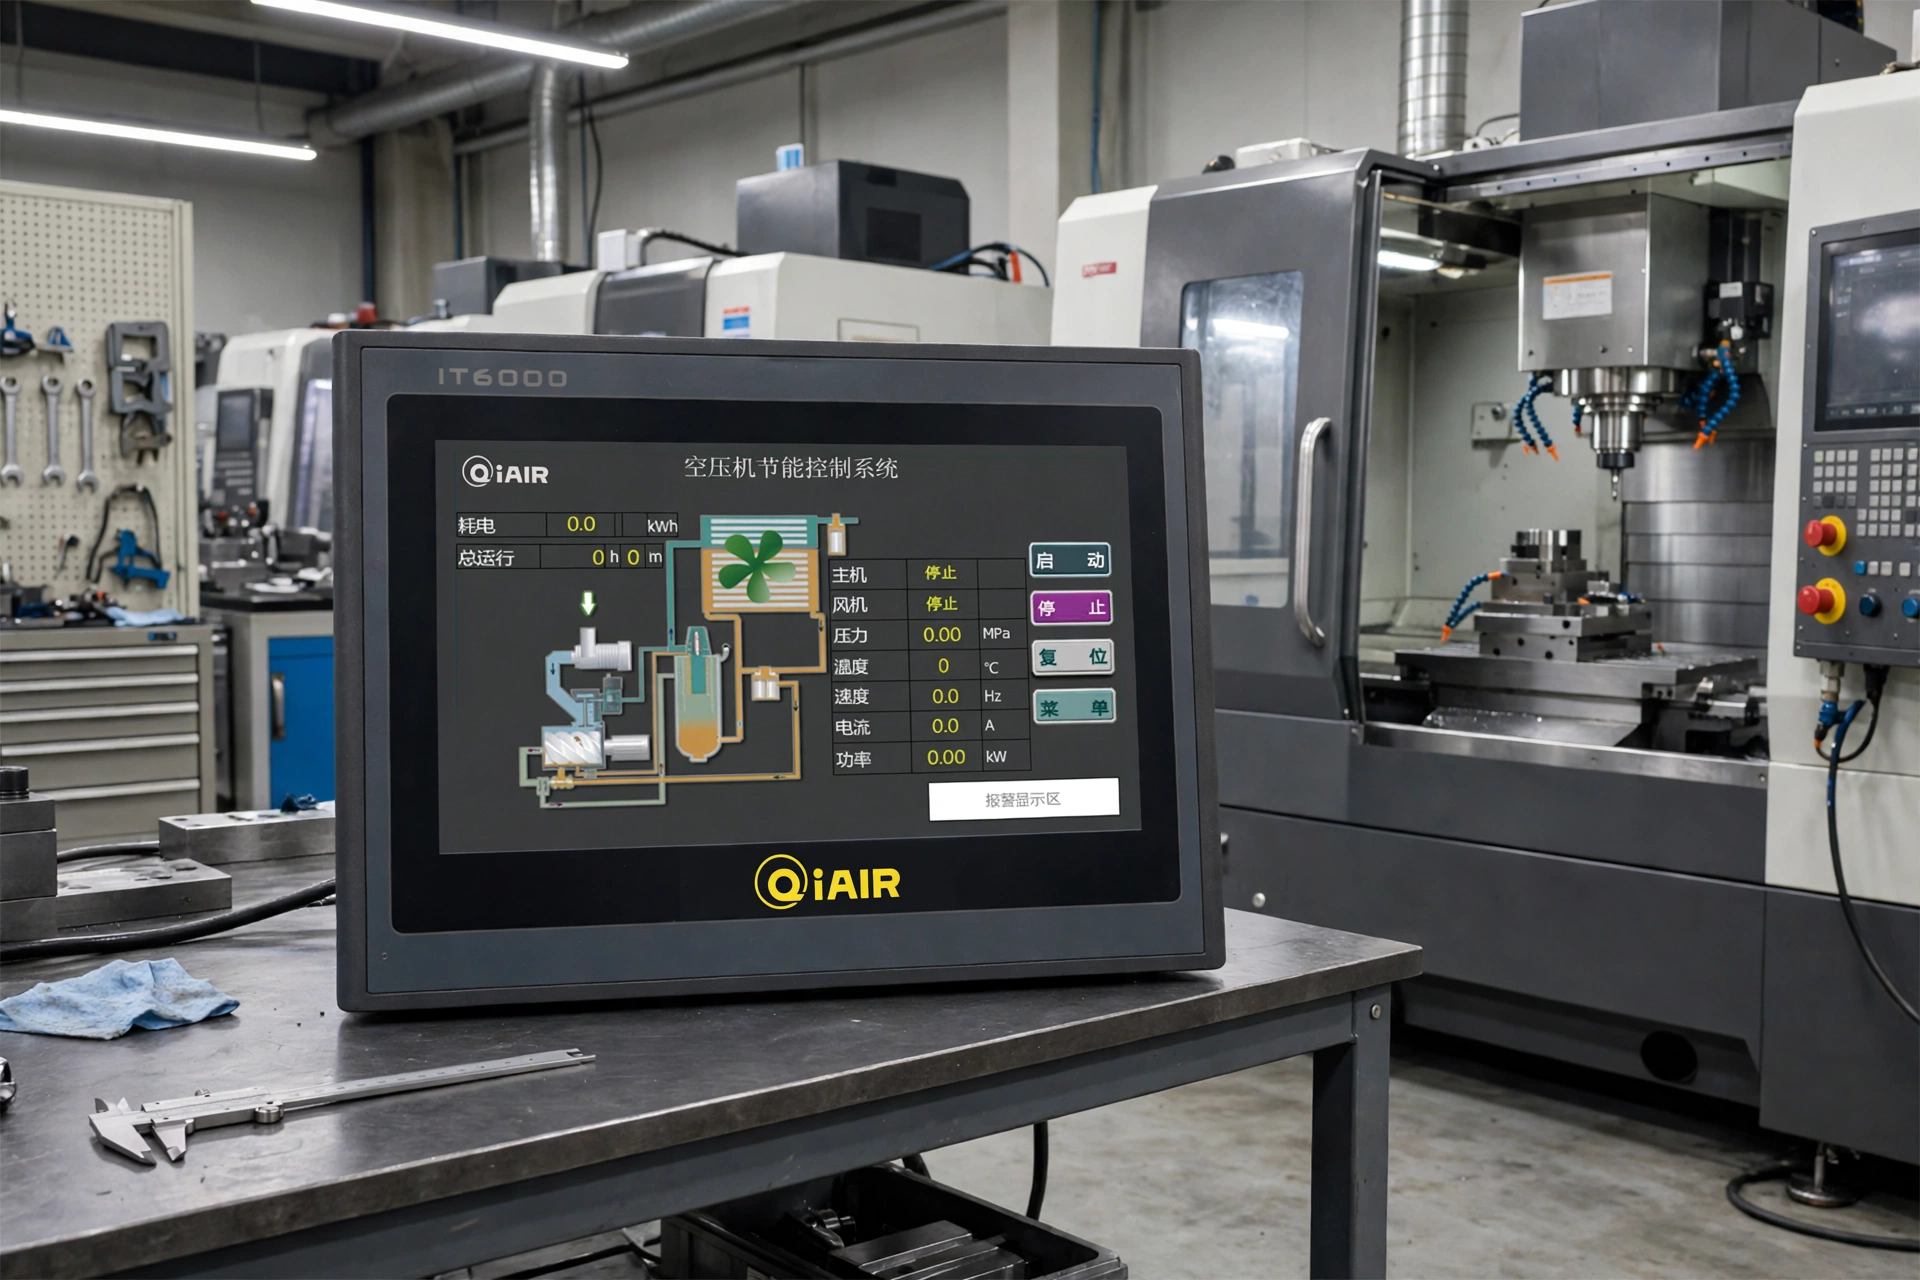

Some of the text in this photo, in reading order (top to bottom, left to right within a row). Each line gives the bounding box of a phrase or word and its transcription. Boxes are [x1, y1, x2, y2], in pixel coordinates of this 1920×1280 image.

[438, 367, 568, 388] IT6000
[684, 454, 899, 480] 空压机节能控制系统
[457, 516, 496, 535] 耗电
[566, 515, 596, 532] 0.0
[647, 518, 679, 533] kWh
[457, 549, 515, 567] 总运行
[592, 549, 663, 566] 0 h 0 m
[831, 566, 868, 584] 主机
[924, 564, 958, 581] 停止
[832, 596, 868, 614] 风机
[925, 595, 959, 612] 停止
[833, 626, 868, 644] 压力
[923, 626, 962, 643] 0.00
[982, 627, 1011, 640] MPa
[833, 658, 869, 676] 温度
[938, 657, 949, 674] 0
[834, 687, 870, 705] 速度
[932, 688, 959, 705] 0.0
[984, 690, 1002, 703] Hz
[835, 718, 871, 736] 电流
[931, 718, 959, 734] 0.0
[984, 720, 996, 732] A
[836, 751, 872, 769] 功率
[927, 749, 966, 765] 0.00
[986, 750, 1008, 763] kW
[985, 791, 1061, 808] 报警显示区
